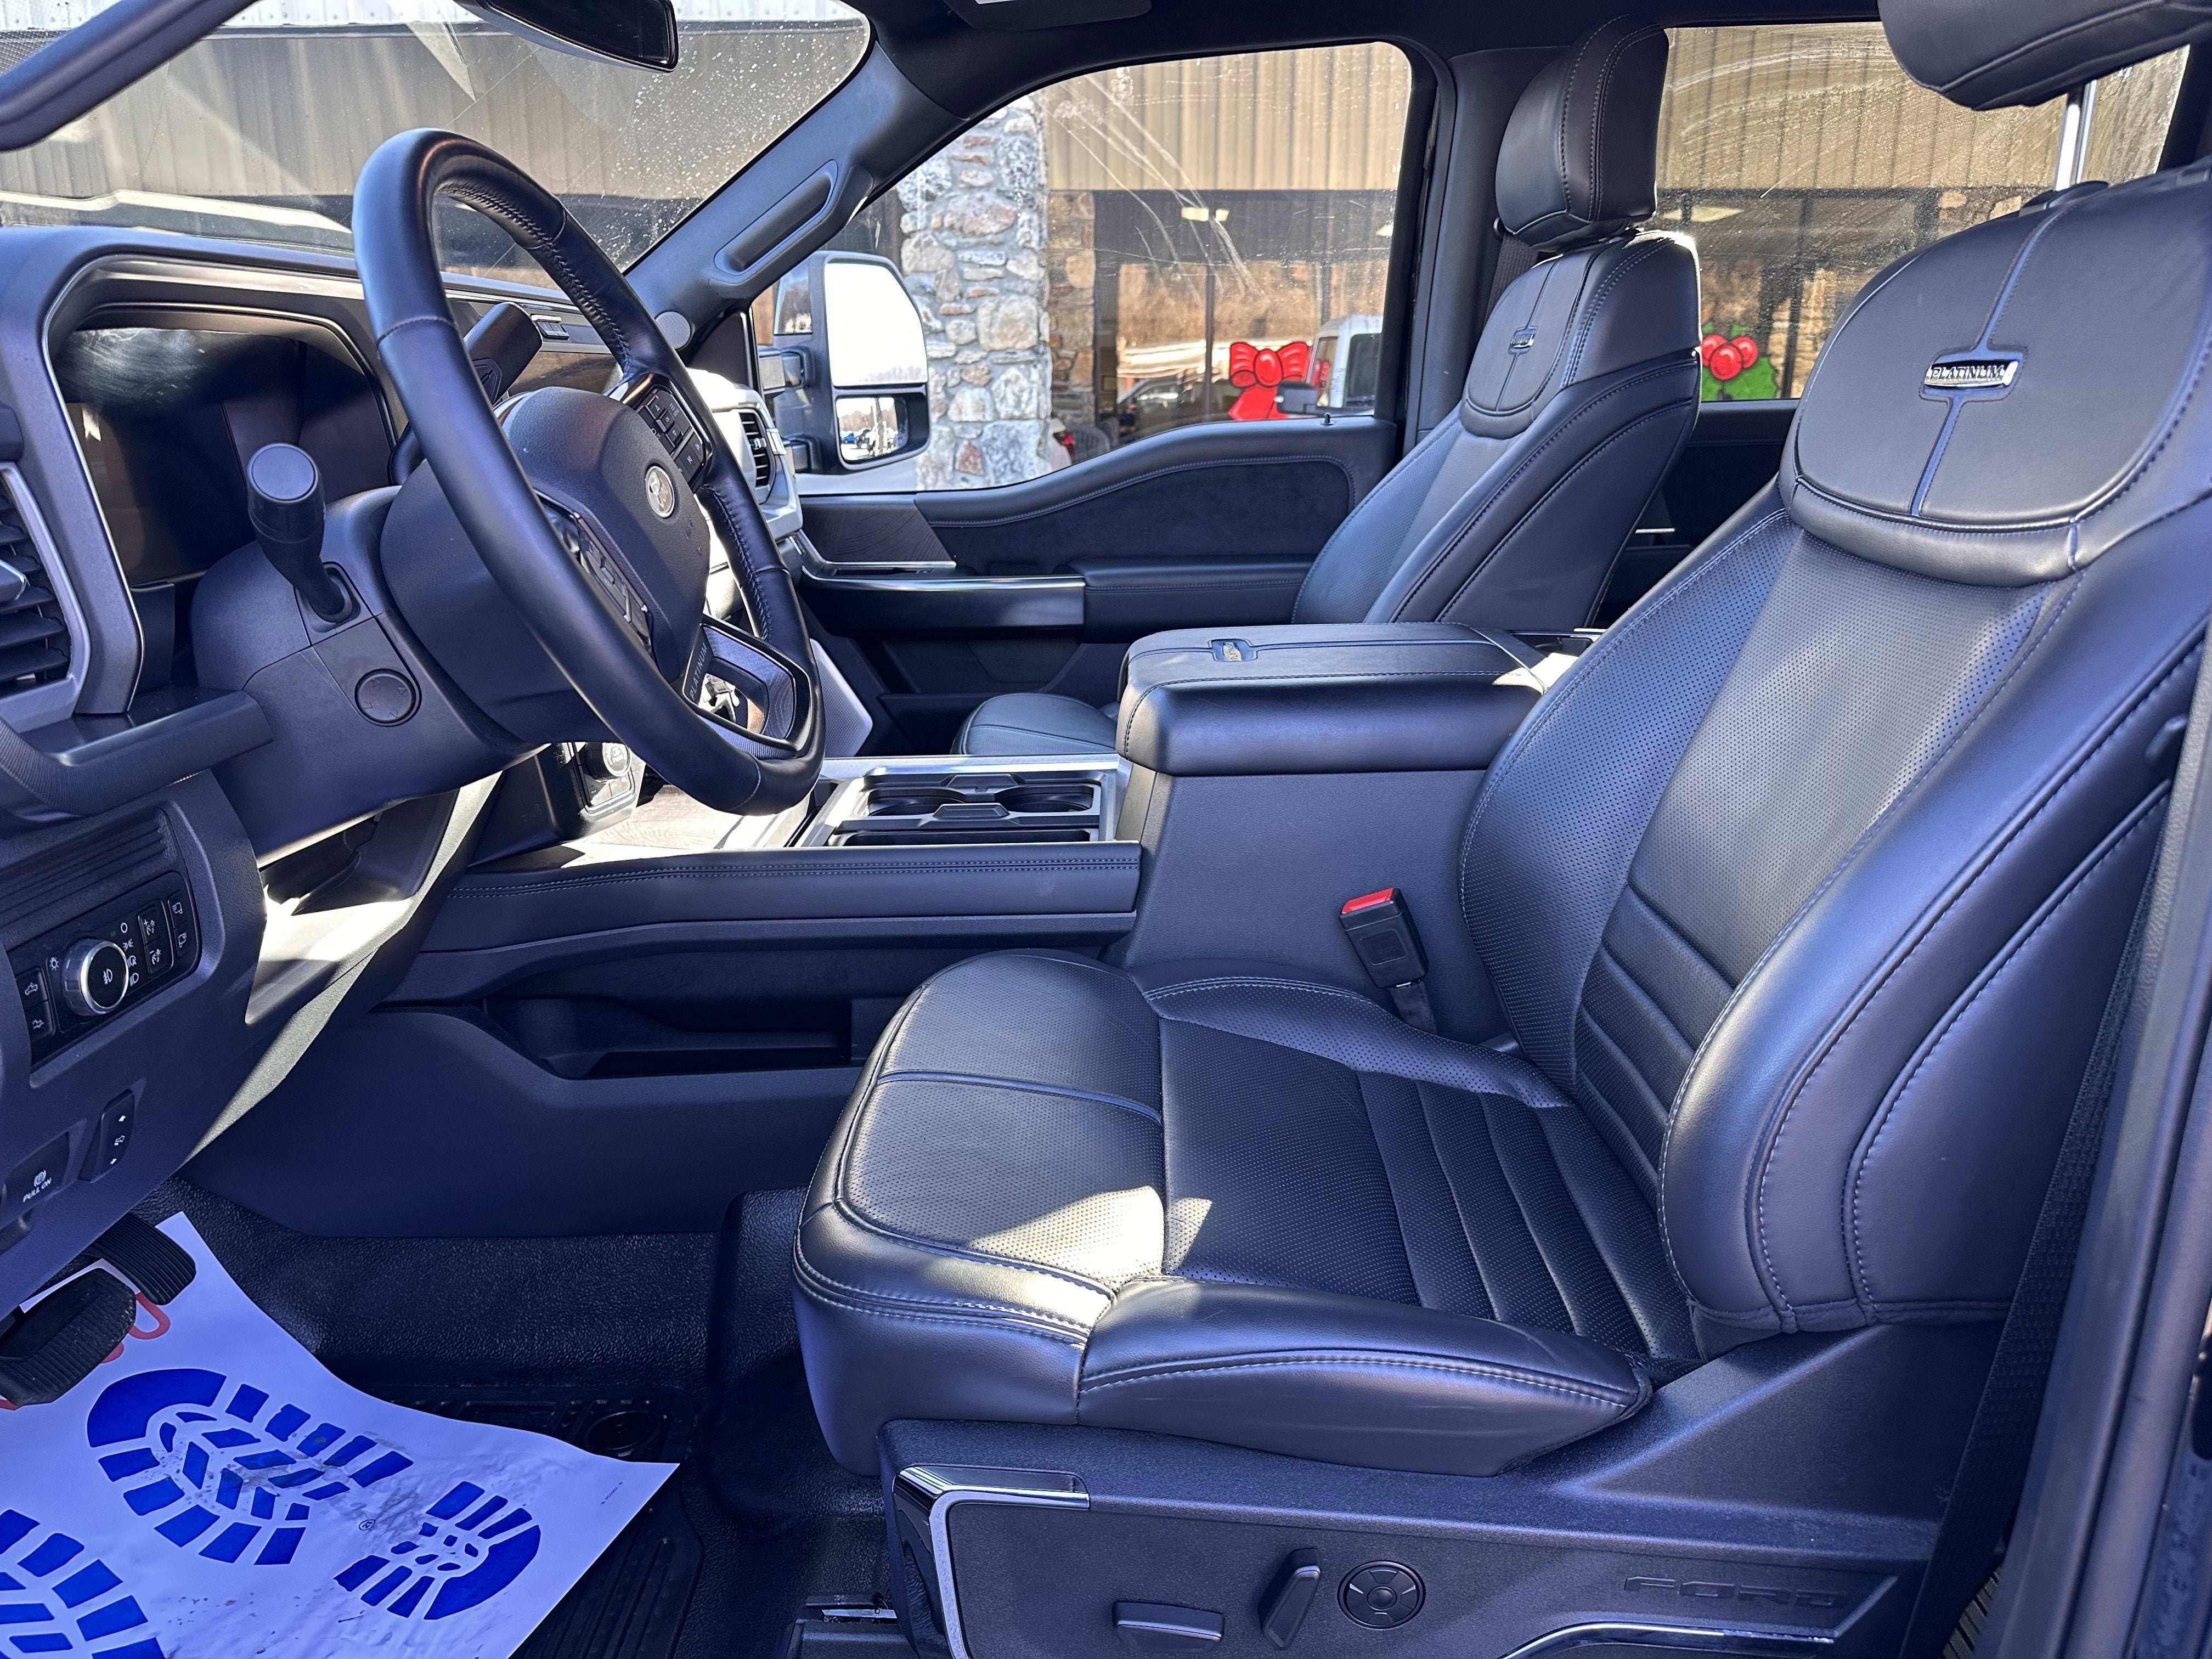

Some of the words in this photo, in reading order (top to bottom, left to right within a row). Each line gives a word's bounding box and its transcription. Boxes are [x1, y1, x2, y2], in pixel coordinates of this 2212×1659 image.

[1929, 364, 2004, 380] PLATINUM
[690, 642, 708, 701] PLATINUM
[23, 1187, 40, 1202] PULL
[41, 1177, 52, 1189] ON
